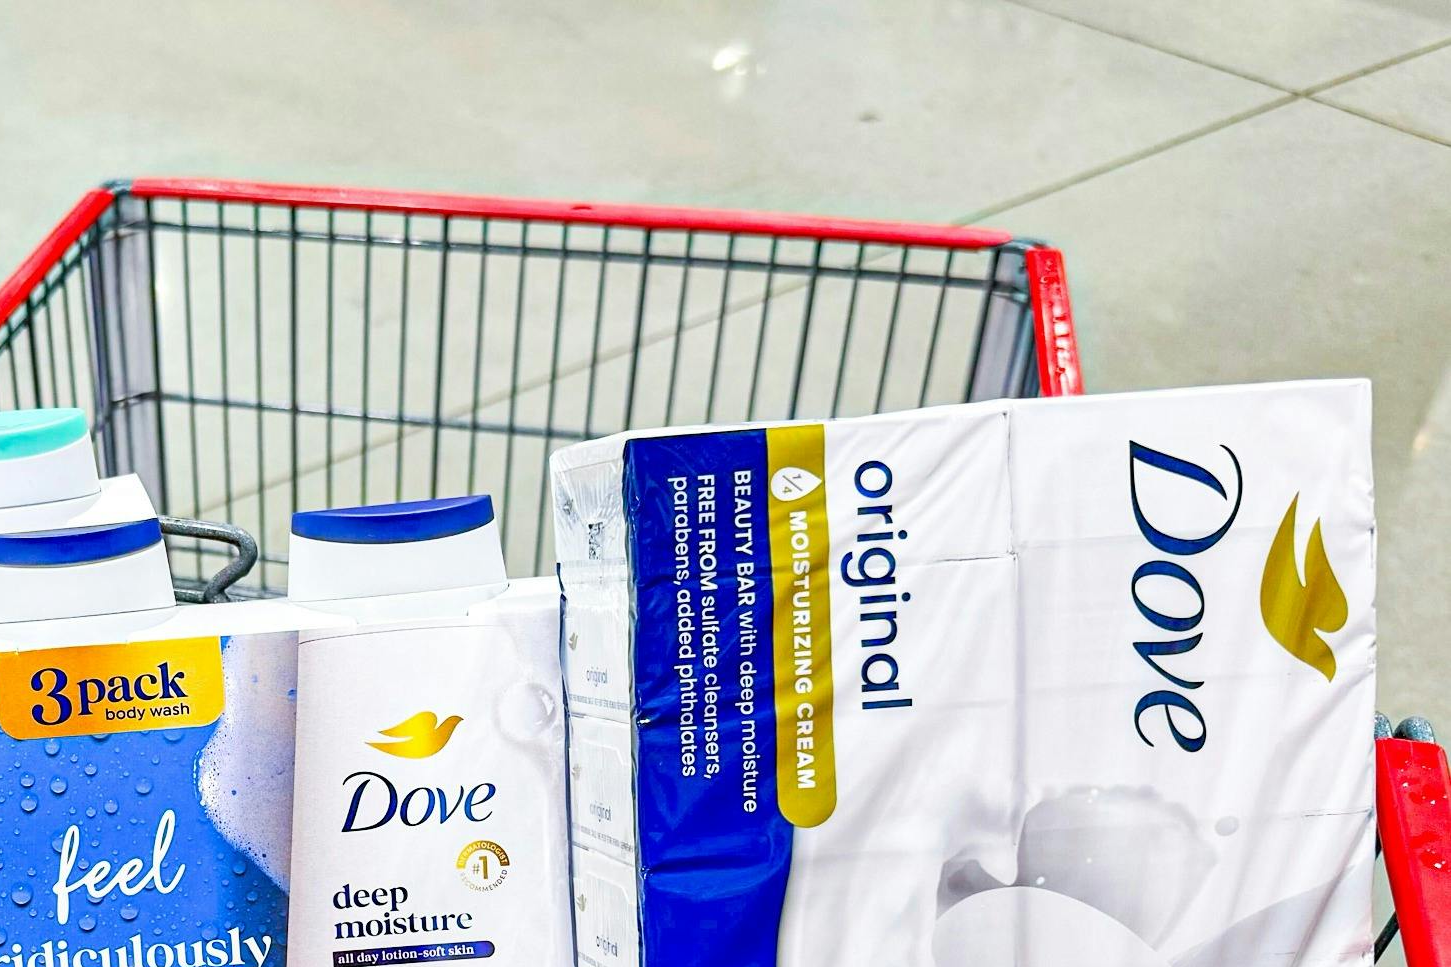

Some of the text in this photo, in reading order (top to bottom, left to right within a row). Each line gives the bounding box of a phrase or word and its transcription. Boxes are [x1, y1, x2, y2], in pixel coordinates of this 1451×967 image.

[668, 476, 698, 777] parabens, added phthalates
[697, 474, 721, 780] FREE FROM sulfate cleansers,
[734, 470, 757, 813] BEAUTY BAR with deep moisture
[841, 460, 913, 709] original
[1129, 440, 1243, 753] Dove
[77, 663, 188, 716] pack
[789, 511, 815, 789] MOISTURIZING CREAM
[105, 704, 190, 722] body wash
[341, 771, 496, 833] Dove
[52, 809, 186, 925] feel
[333, 884, 408, 912] deep
[334, 912, 473, 939] moisture
[338, 944, 475, 965] all day lotion-soft skin
